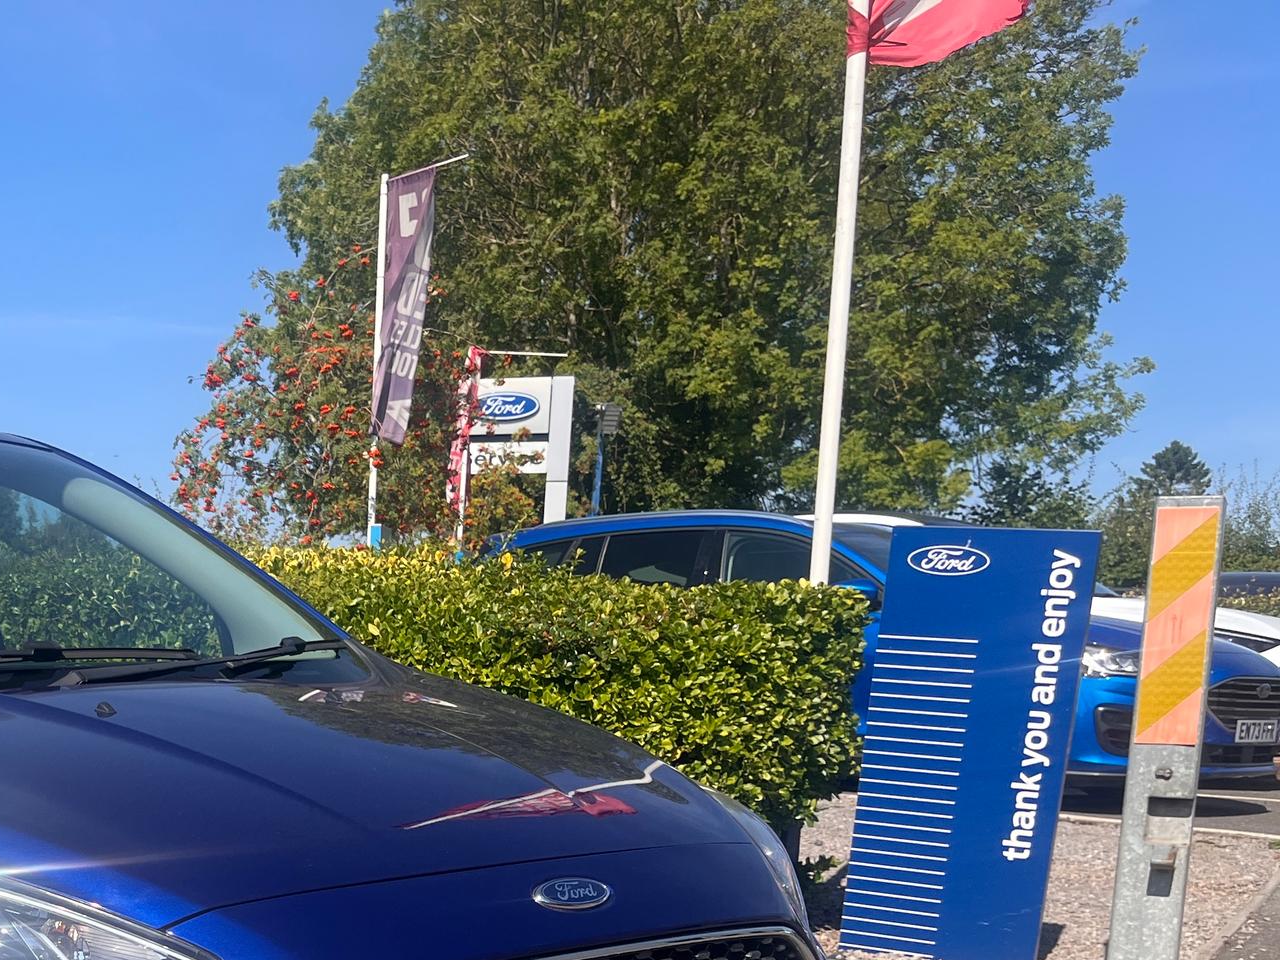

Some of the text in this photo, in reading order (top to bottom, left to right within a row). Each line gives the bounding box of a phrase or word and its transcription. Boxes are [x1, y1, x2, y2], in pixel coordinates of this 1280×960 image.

[483, 396, 526, 414] Ford
[921, 549, 976, 571] Ford
[1002, 549, 1081, 860] thank you and enjoy
[555, 881, 597, 900] Ford
